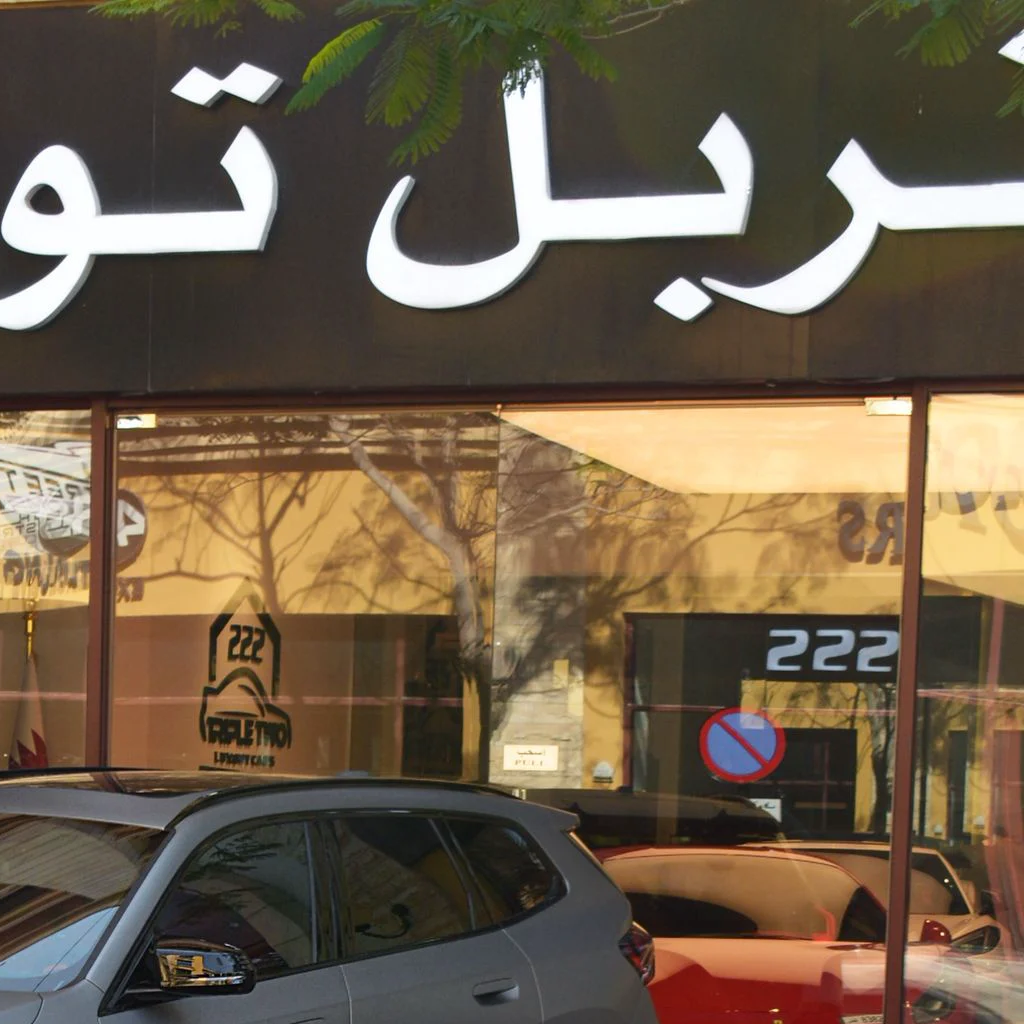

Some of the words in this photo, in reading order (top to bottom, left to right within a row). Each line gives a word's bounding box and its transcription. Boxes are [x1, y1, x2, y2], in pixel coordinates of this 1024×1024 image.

[366, 29, 1024, 322] ربل
[227, 624, 266, 664] 222
[766, 629, 900, 672] 222
